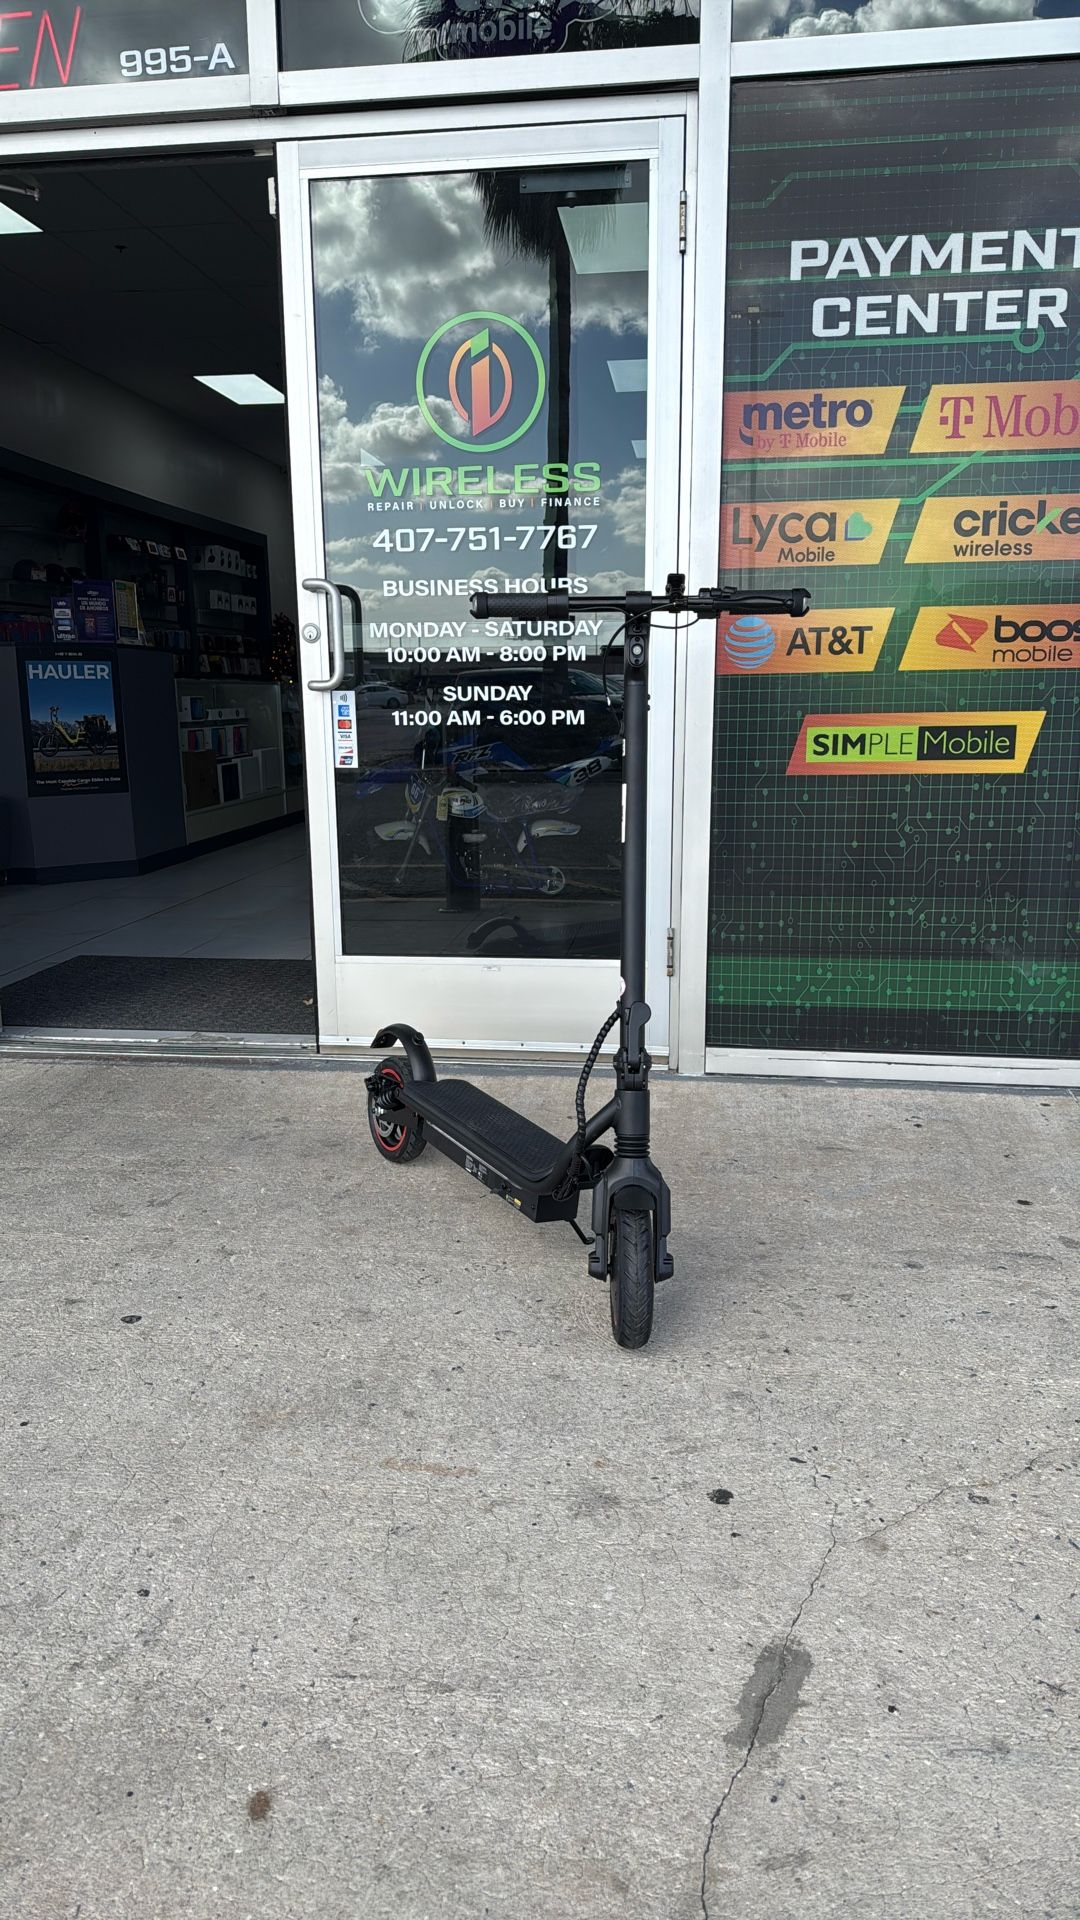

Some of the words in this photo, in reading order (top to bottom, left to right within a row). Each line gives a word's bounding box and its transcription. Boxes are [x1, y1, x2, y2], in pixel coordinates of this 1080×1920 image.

[450, 12, 553, 44] mobile
[120, 42, 236, 77] 995-A
[812, 287, 1068, 338] CENTER
[743, 393, 872, 430] metro
[757, 433, 775, 452] by
[796, 431, 847, 448] Mobile
[364, 461, 601, 498] WIRELESS
[367, 500, 414, 512] REPAIR
[429, 499, 484, 510] UNLOCK
[499, 498, 525, 508] BUY
[540, 496, 601, 507] FINANCE
[372, 524, 598, 552] 407-751-7767
[732, 507, 837, 552] Lyca
[777, 547, 836, 564] Mobile
[953, 540, 1033, 557] wireless
[383, 578, 498, 597] BUSINESS
[504, 577, 588, 594] HOURS
[369, 621, 467, 639] MONDAY
[485, 619, 603, 637] SATURDAY
[786, 625, 873, 656] AT&T
[384, 647, 441, 663] 10:00
[446, 646, 480, 662] AM
[499, 646, 547, 662] 8:00
[552, 645, 587, 661] PM
[992, 645, 1073, 662] mobile
[28, 664, 110, 679] HAULER
[442, 685, 533, 702] SUNDAY
[391, 710, 445, 726] 11:00
[446, 710, 481, 726] AM
[499, 709, 546, 726] 6:00
[551, 709, 586, 725] PM
[812, 732, 914, 757] SIMPLE
[923, 730, 1011, 756] Mobile
[573, 757, 602, 785] 38
